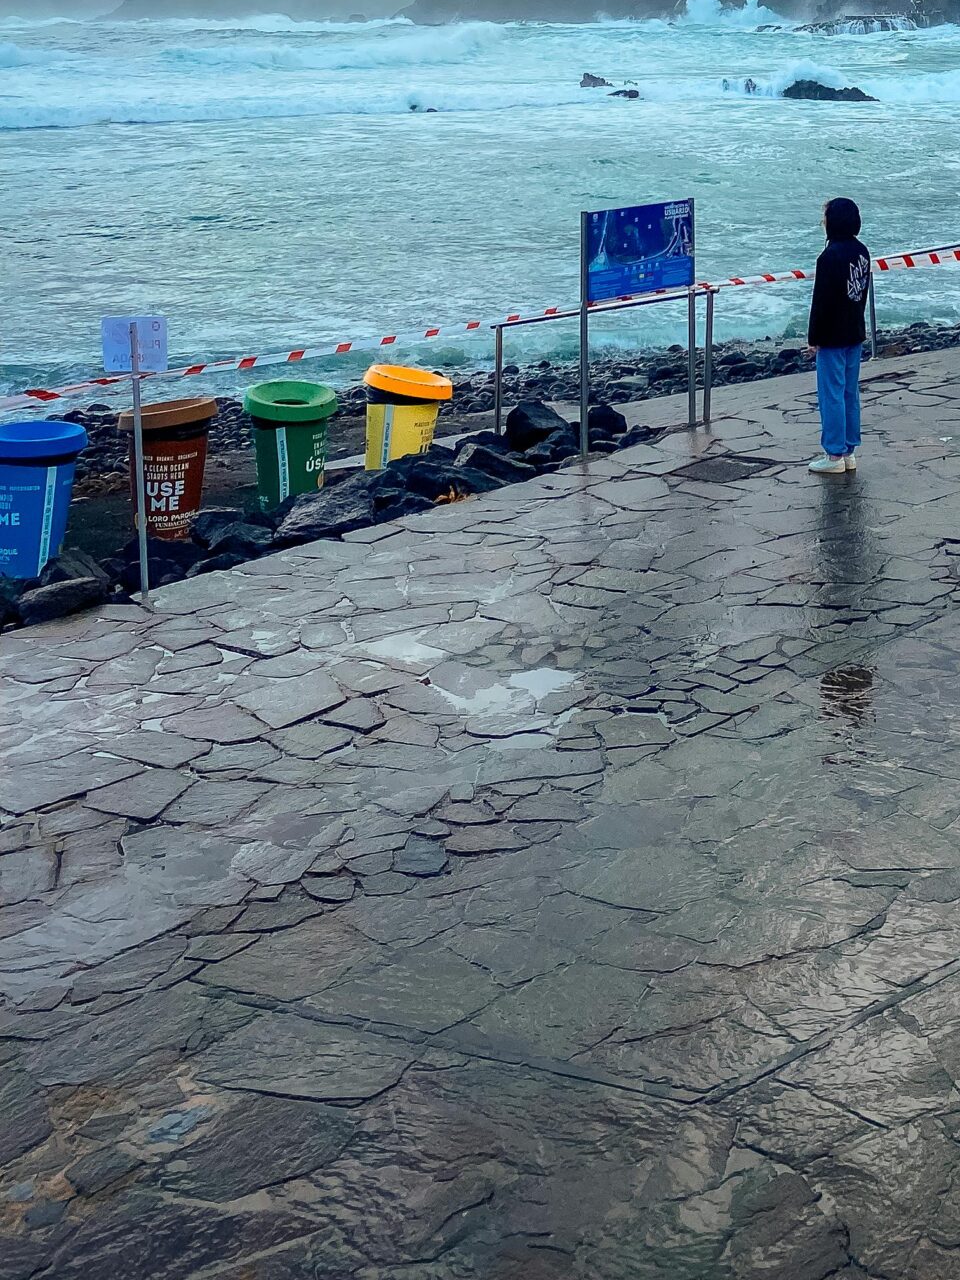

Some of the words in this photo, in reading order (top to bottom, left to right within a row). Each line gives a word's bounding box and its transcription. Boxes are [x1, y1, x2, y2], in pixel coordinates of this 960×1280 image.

[170, 463, 189, 471] OCEAN
[170, 472, 185, 480] HERE
[146, 480, 185, 496] USE
[151, 496, 180, 511] ME
